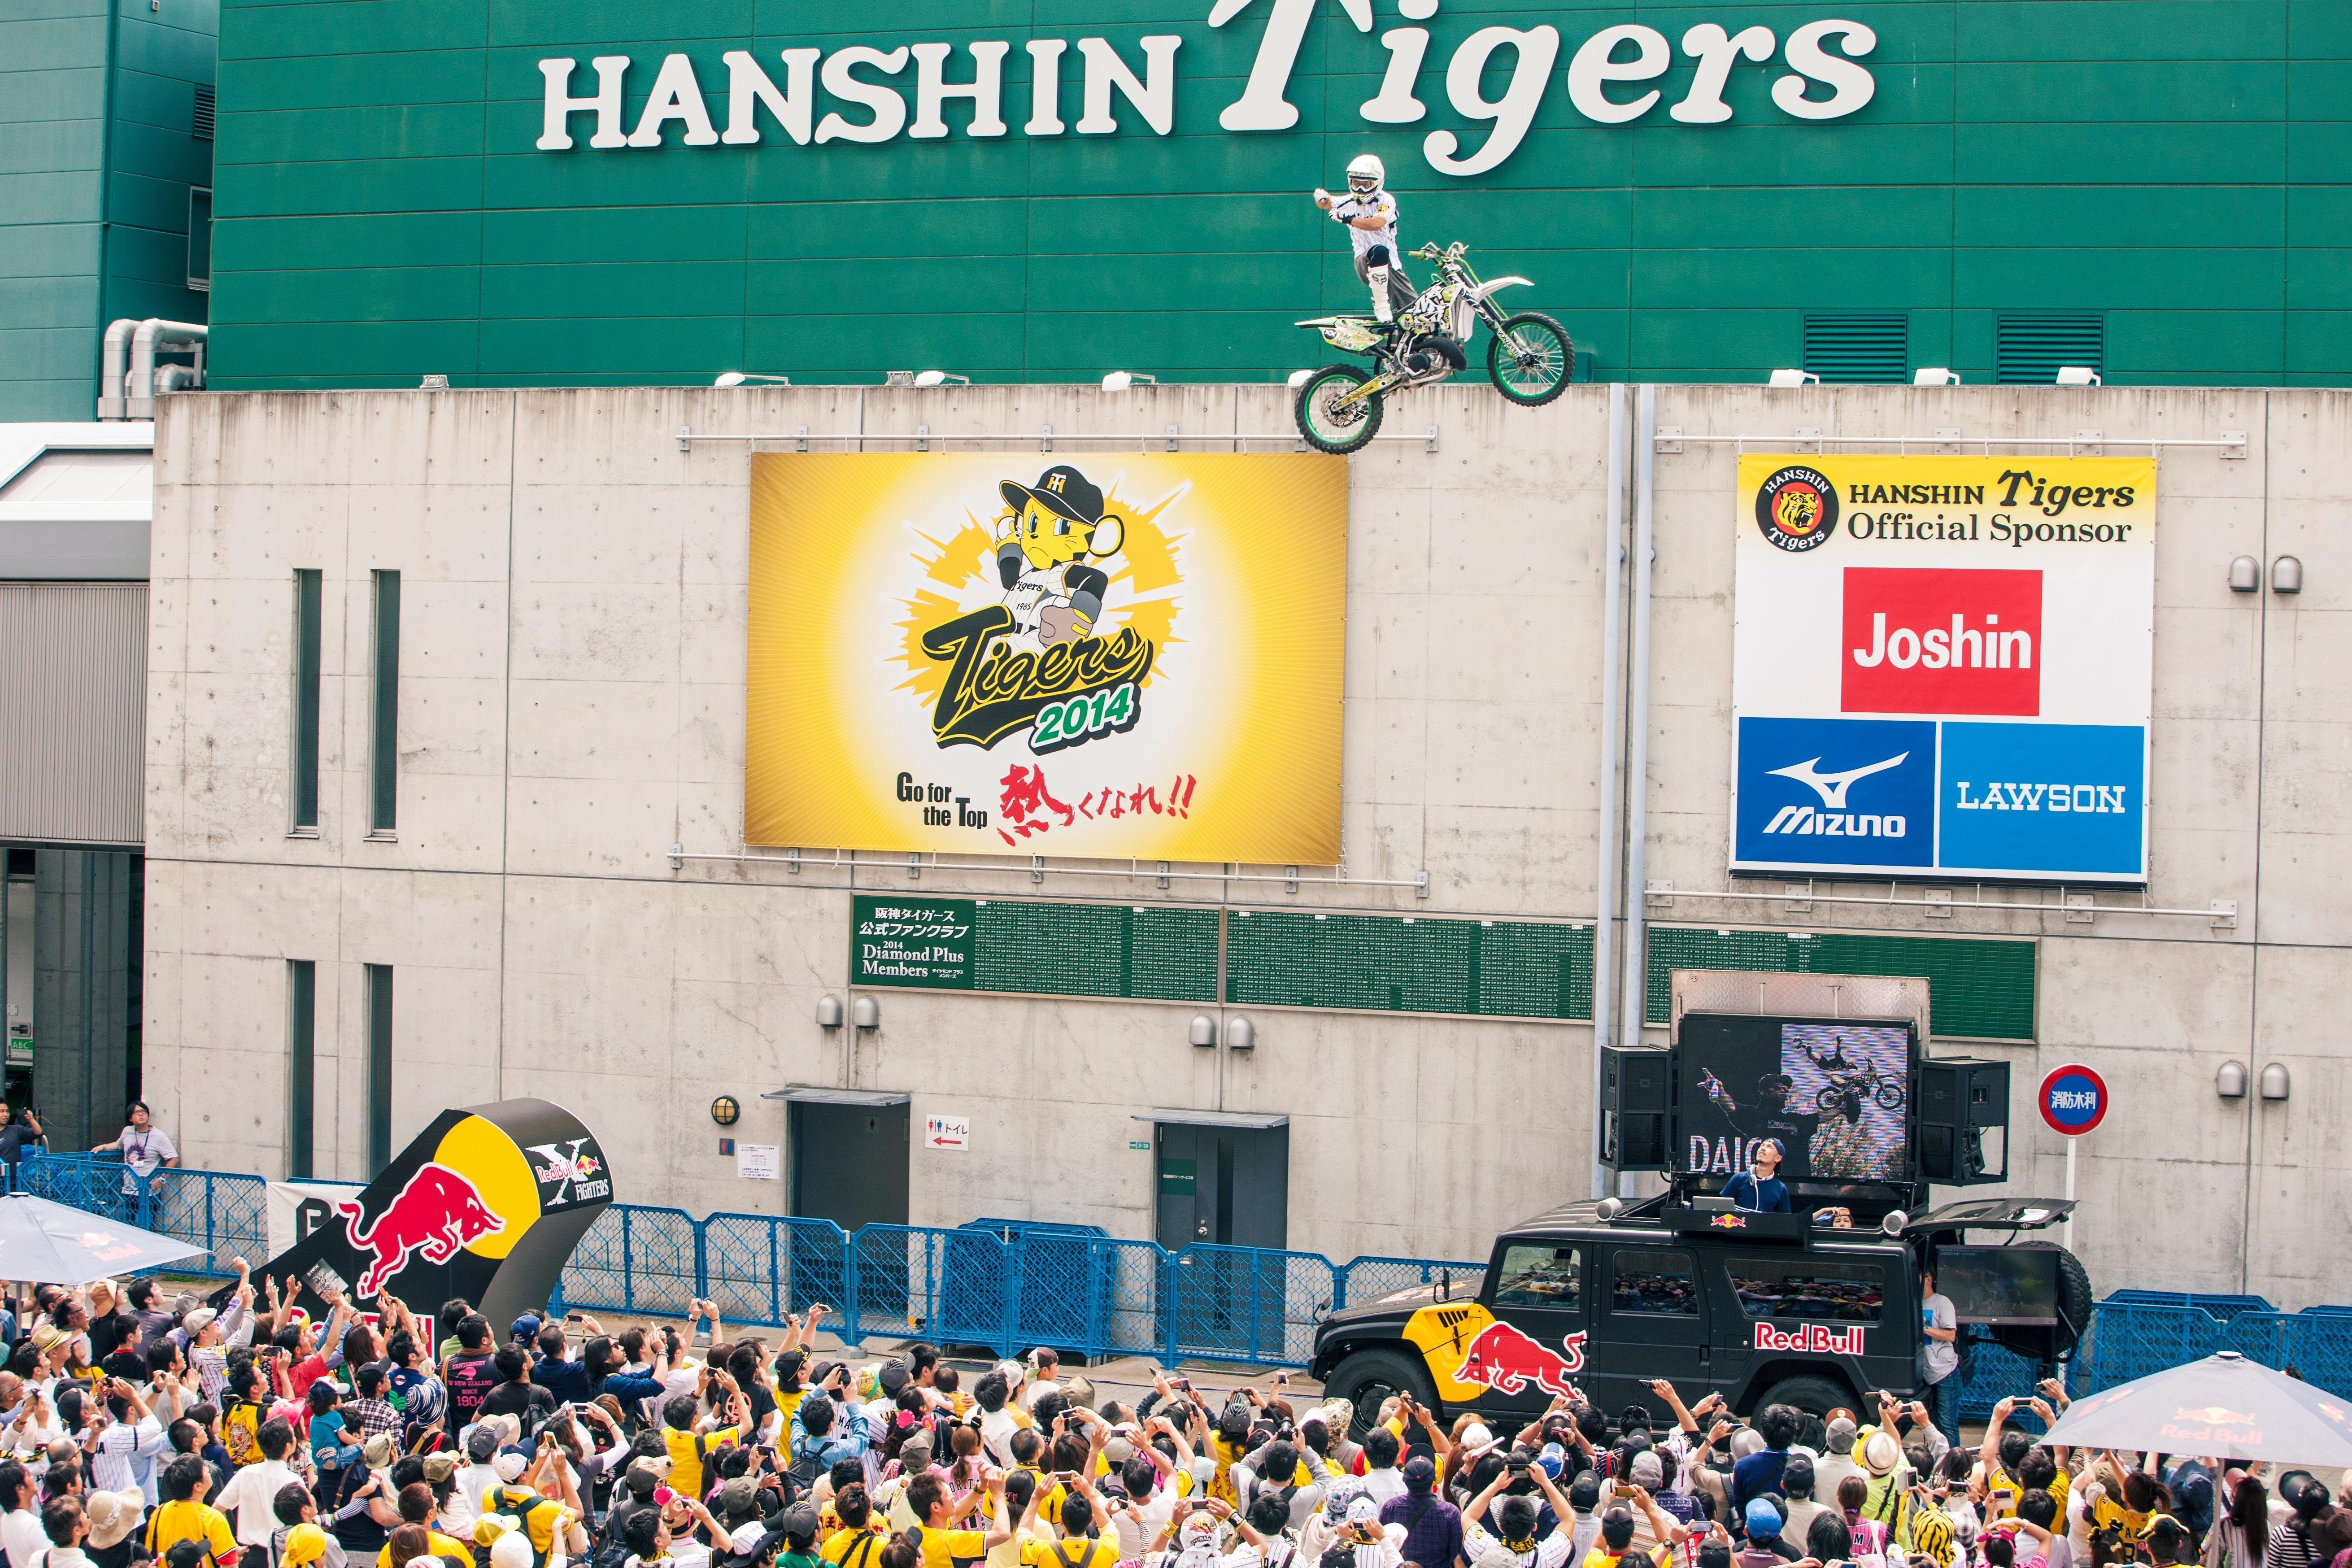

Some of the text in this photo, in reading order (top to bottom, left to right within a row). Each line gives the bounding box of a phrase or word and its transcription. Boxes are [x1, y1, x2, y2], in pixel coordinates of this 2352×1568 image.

[536, 0, 1877, 176] HANSHIN Tigers
[1764, 469, 1829, 494] HANSHIN
[1849, 469, 2135, 517] HANSHIN Tigers
[1768, 526, 1825, 552] Tigers
[1847, 512, 2132, 547] Official Sponsor
[1853, 612, 2032, 669] Joshin
[922, 603, 1153, 751] Tigers
[1035, 686, 1132, 746] 2014
[897, 772, 952, 803] Go for
[1957, 781, 2126, 814] LAWSON
[924, 797, 987, 829] the Top
[875, 907, 955, 922] 阪神タイガース
[859, 921, 969, 939] 公式ファンクラブ
[862, 944, 964, 963] Diamond Plus
[883, 941, 903, 949] 2014
[862, 959, 928, 977] Members
[2051, 1091, 2096, 1110] 消防水利
[946, 1124, 967, 1135] トイレ
[575, 1179, 609, 1201] FIGHTERS
[452, 1360, 486, 1369] CANTERBURY
[457, 1395, 485, 1406] 1904
[2160, 1424, 2264, 1445] Red Bull
